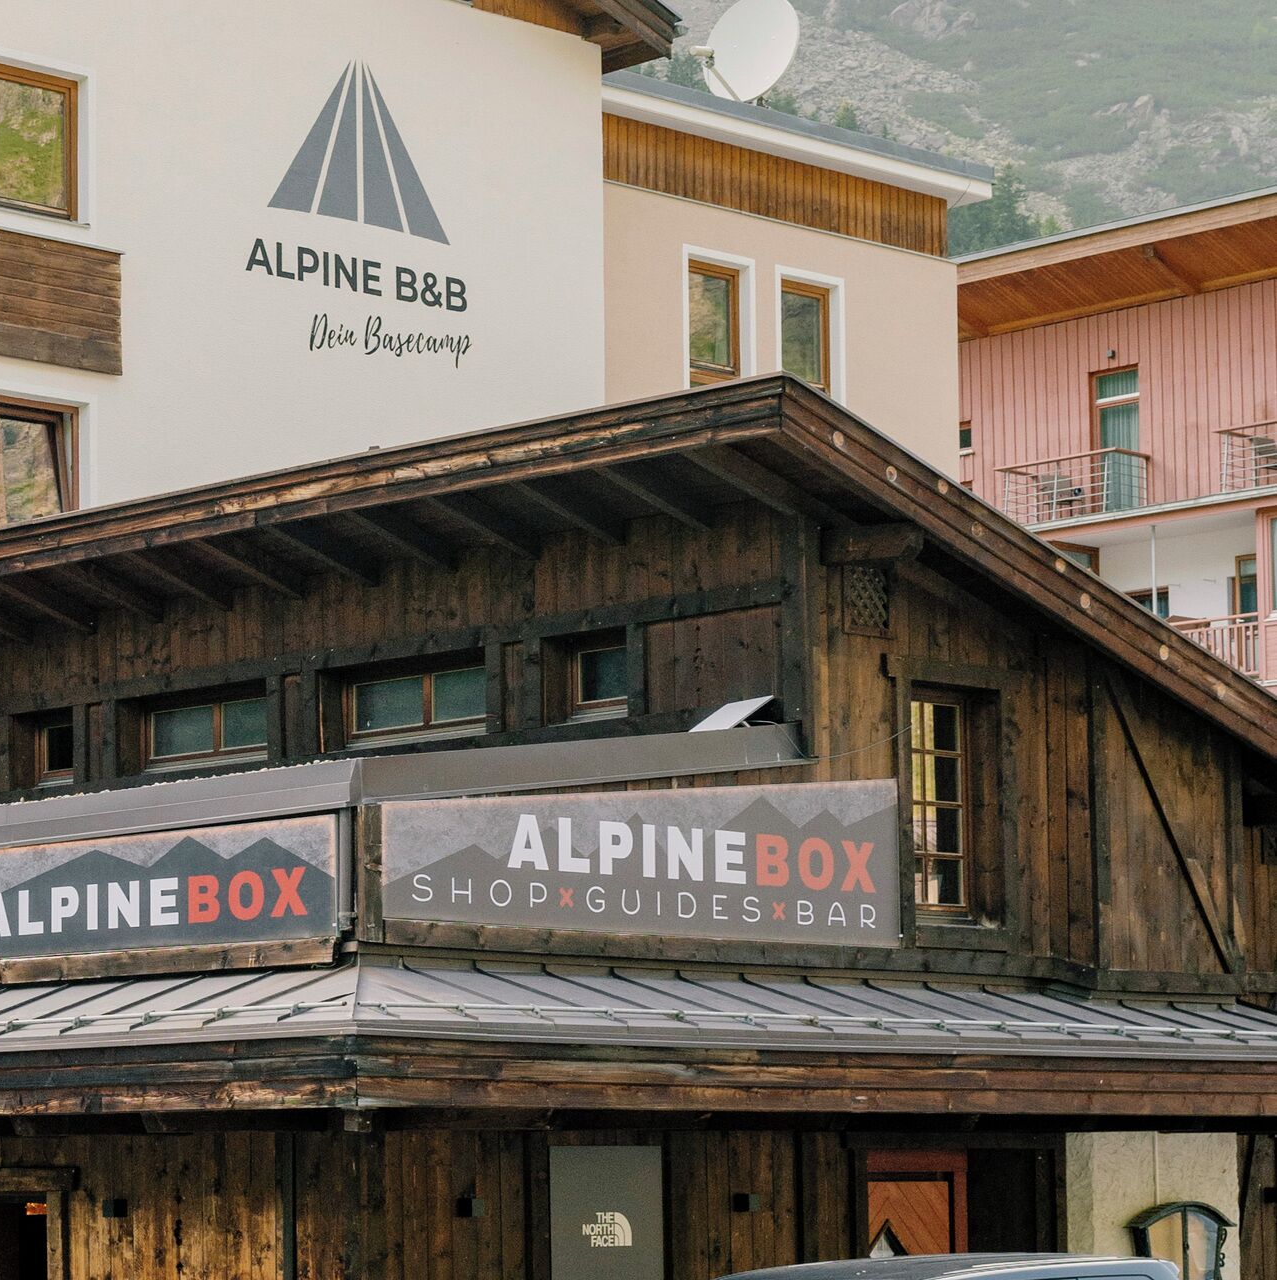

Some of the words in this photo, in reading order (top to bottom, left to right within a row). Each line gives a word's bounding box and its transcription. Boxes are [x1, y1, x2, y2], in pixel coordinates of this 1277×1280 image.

[245, 238, 382, 297] ALPINE
[395, 266, 468, 312] B&B
[309, 313, 358, 351] Dein
[364, 315, 472, 369] Basecamp
[507, 813, 876, 894] ALPINEBOX
[582, 1224, 614, 1236] NORTH
[595, 1212, 614, 1223] THE
[590, 1235, 615, 1248] FACE
